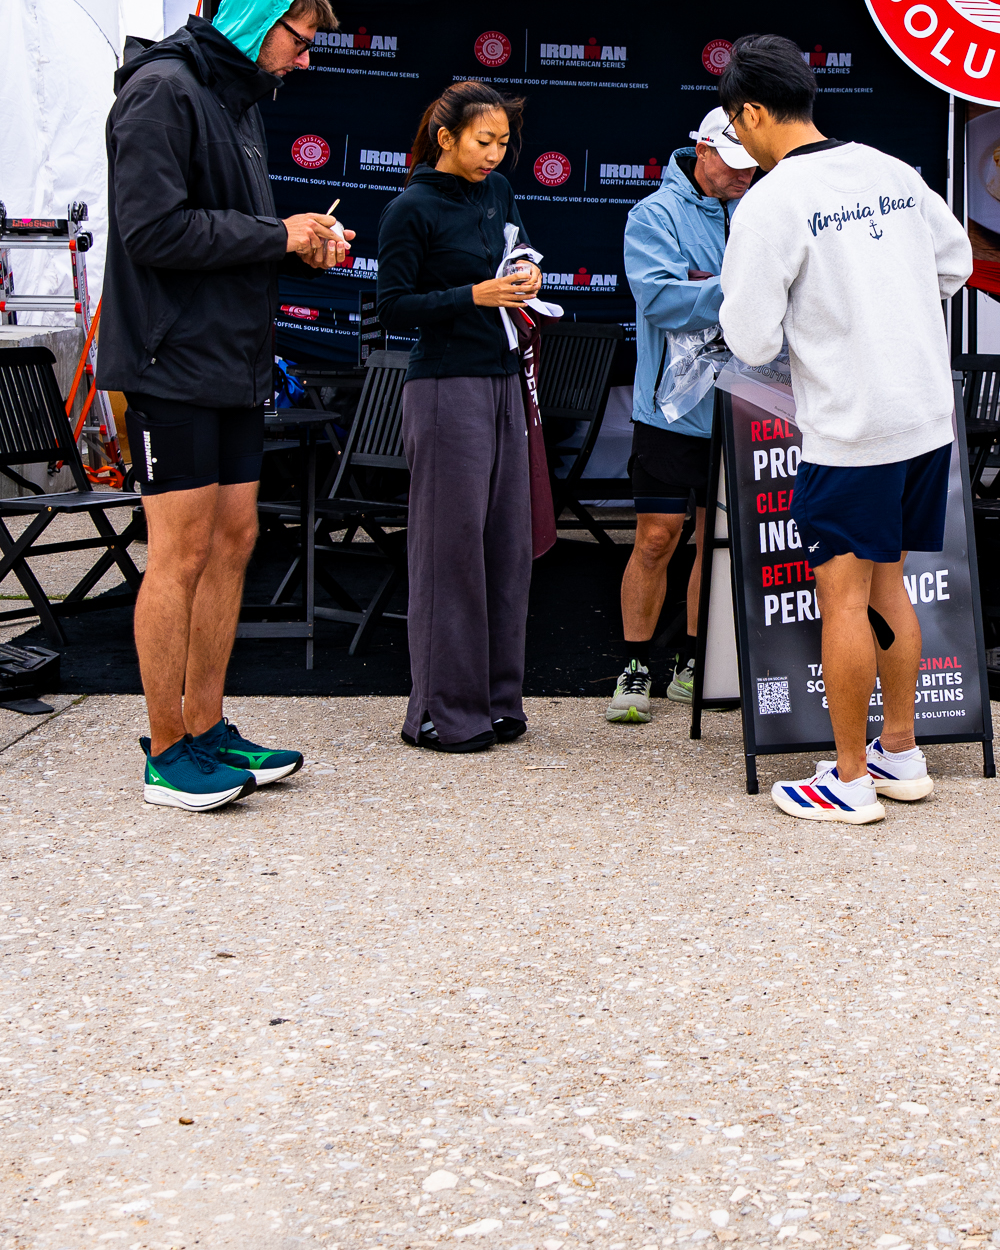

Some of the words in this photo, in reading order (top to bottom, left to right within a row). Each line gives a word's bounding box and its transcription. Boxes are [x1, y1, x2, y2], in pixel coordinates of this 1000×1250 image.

[312, 27, 397, 51] RONMAN
[479, 33, 507, 43] CUISINE
[334, 48, 371, 57] AMERICAN
[372, 50, 396, 58] SERIES
[540, 37, 627, 61] IRONMAN
[477, 51, 509, 65] SOLUTIONS
[540, 59, 564, 67] NORTH
[565, 60, 600, 68] AMERICAN
[602, 61, 626, 69] SERIES
[368, 69, 398, 78] AMERICAN
[598, 81, 629, 89] AMERICAN
[298, 136, 326, 148] CUISINE
[294, 153, 327, 167] SOLUTIONS
[360, 149, 411, 166] IRON
[539, 153, 566, 164] CUISINE
[360, 164, 385, 172] NORTH
[600, 158, 667, 179] IRONM
[283, 176, 309, 184] OFFICIAL
[368, 184, 396, 192] IRONMAN
[536, 171, 568, 185] SOLUTIONS
[600, 178, 624, 186] NORTH
[625, 179, 660, 187] AMERICAN
[807, 203, 874, 237] Virginia
[277, 321, 303, 330] OFFICIAL
[751, 418, 794, 442] REAL
[762, 560, 815, 588] BETTE
[922, 672, 963, 687] BITES
[921, 710, 966, 719] SOLUTIONS
